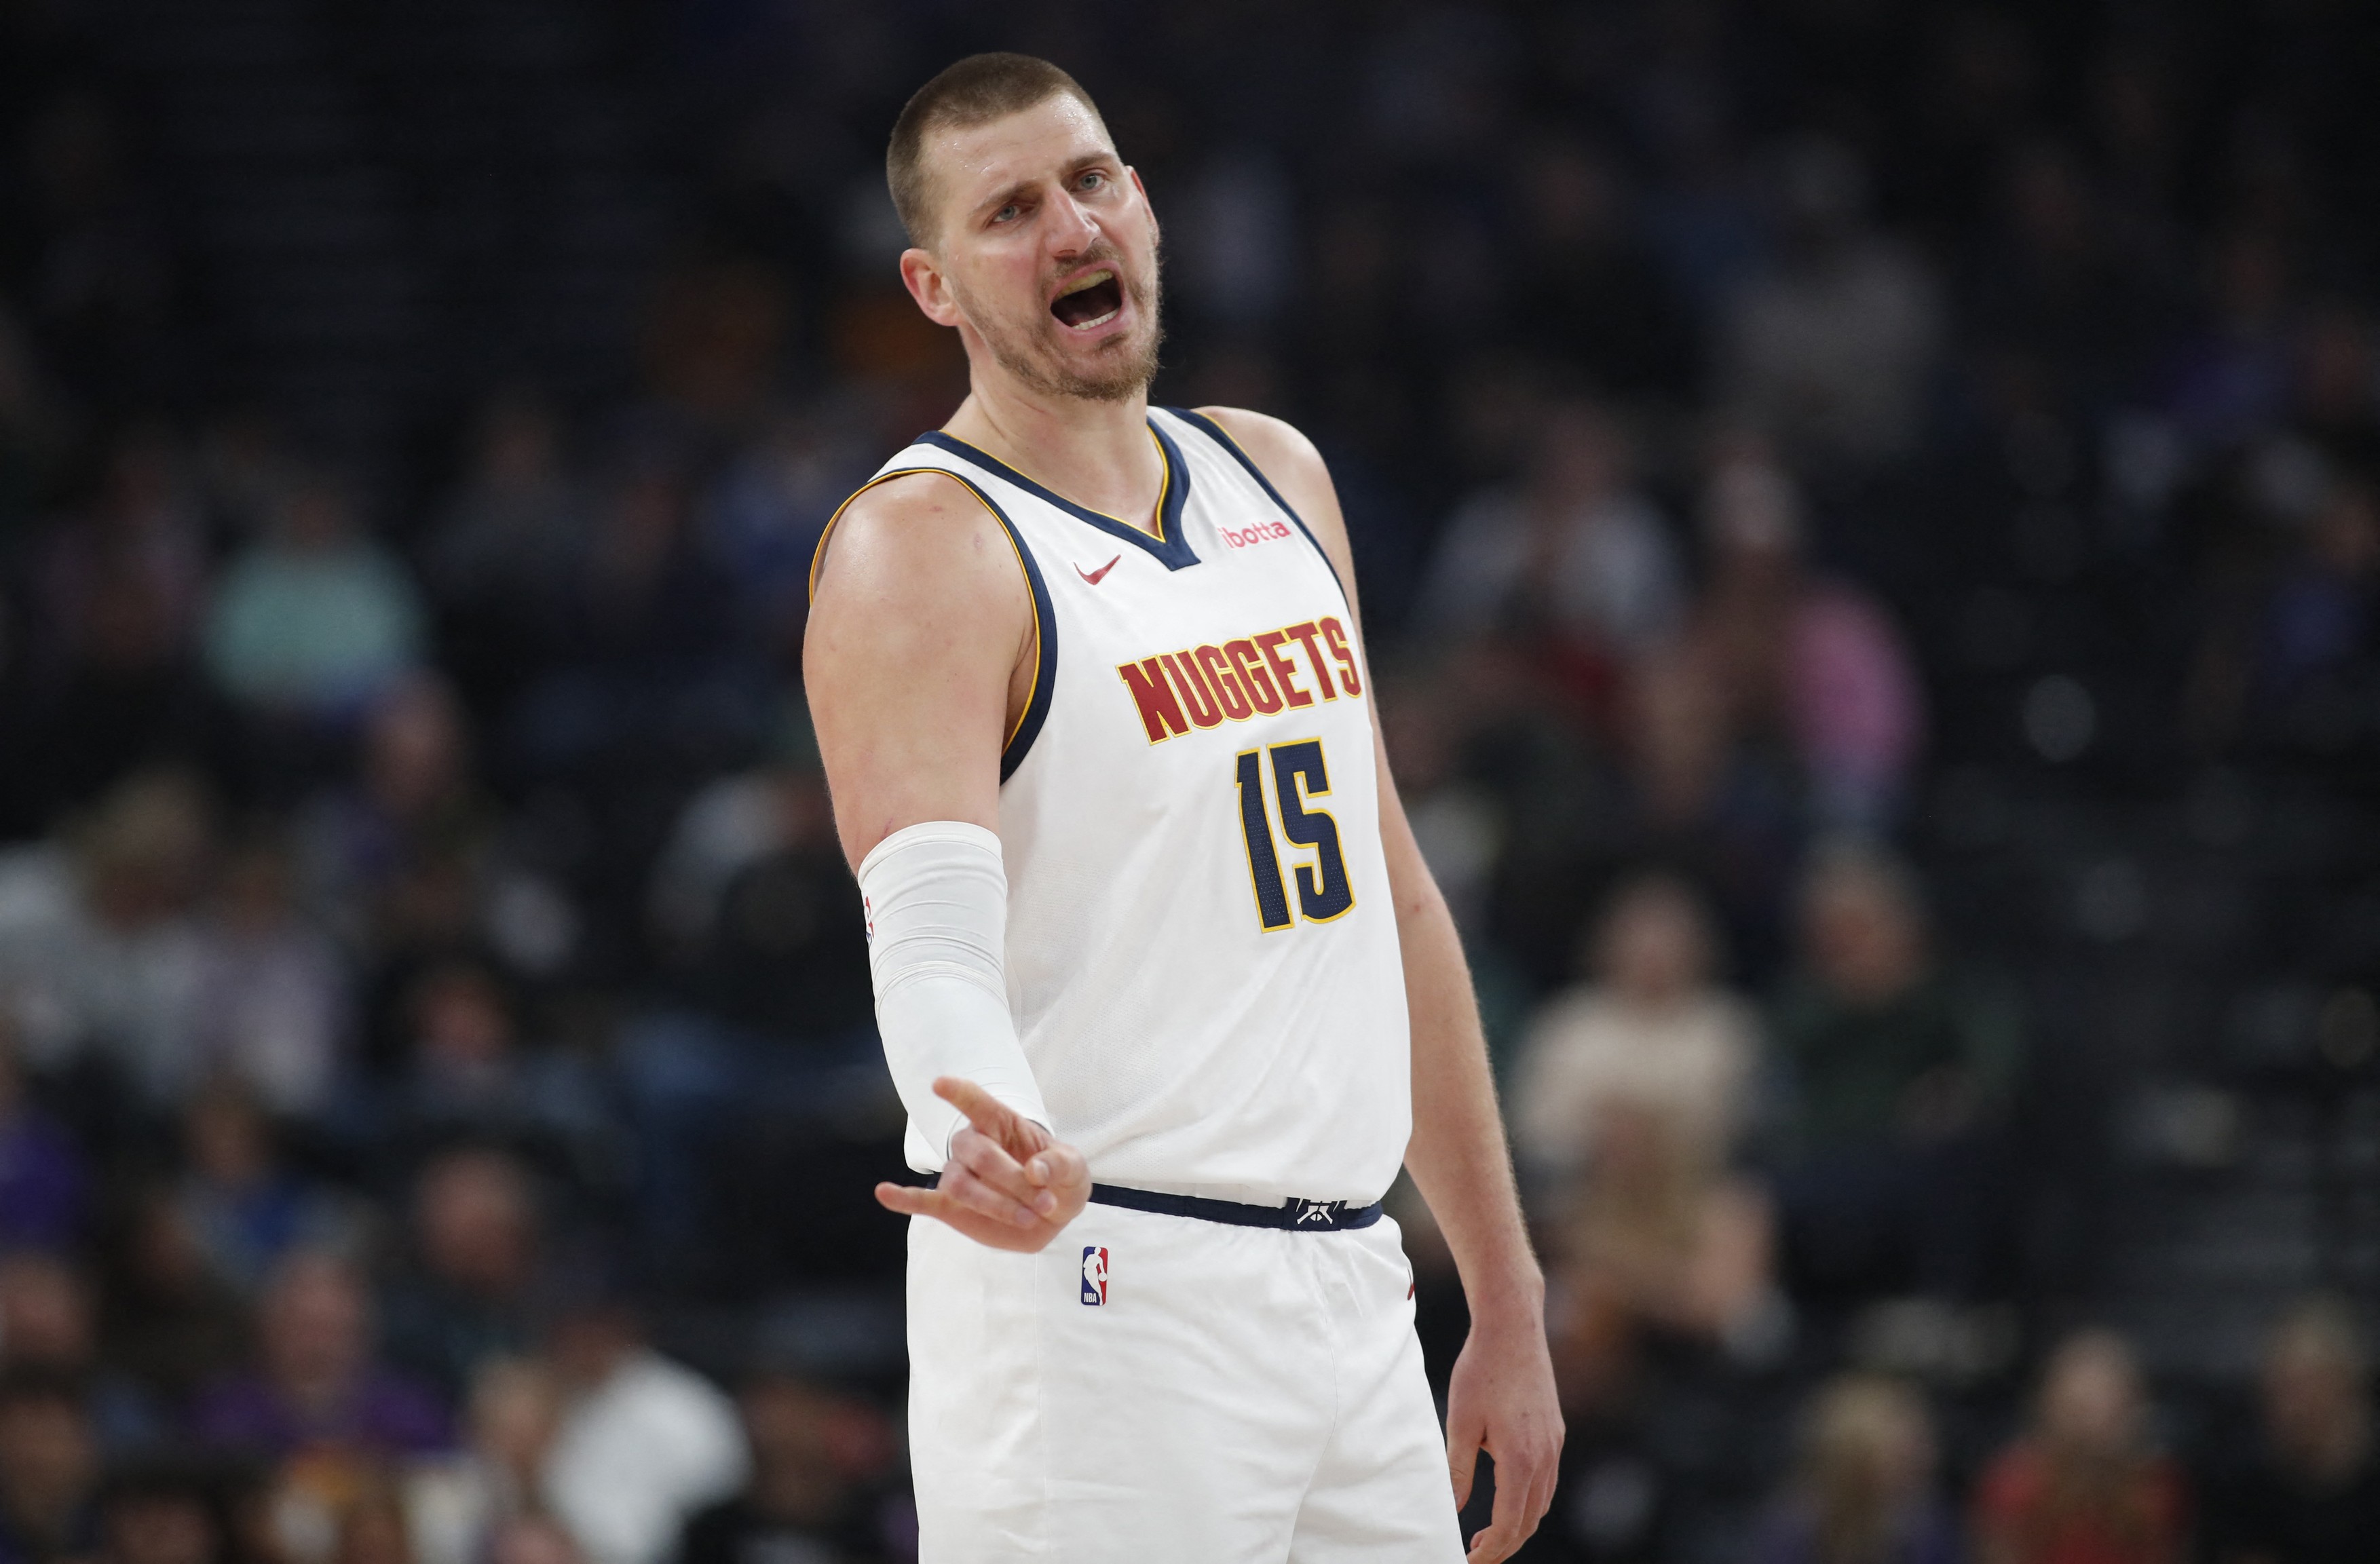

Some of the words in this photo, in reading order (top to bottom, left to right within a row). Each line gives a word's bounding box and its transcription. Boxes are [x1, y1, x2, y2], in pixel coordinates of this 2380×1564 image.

[1217, 521, 1291, 548] ibotta
[1115, 615, 1362, 746] NUGGETS
[1234, 736, 1356, 934] 15
[1084, 1293, 1097, 1303] NBA
